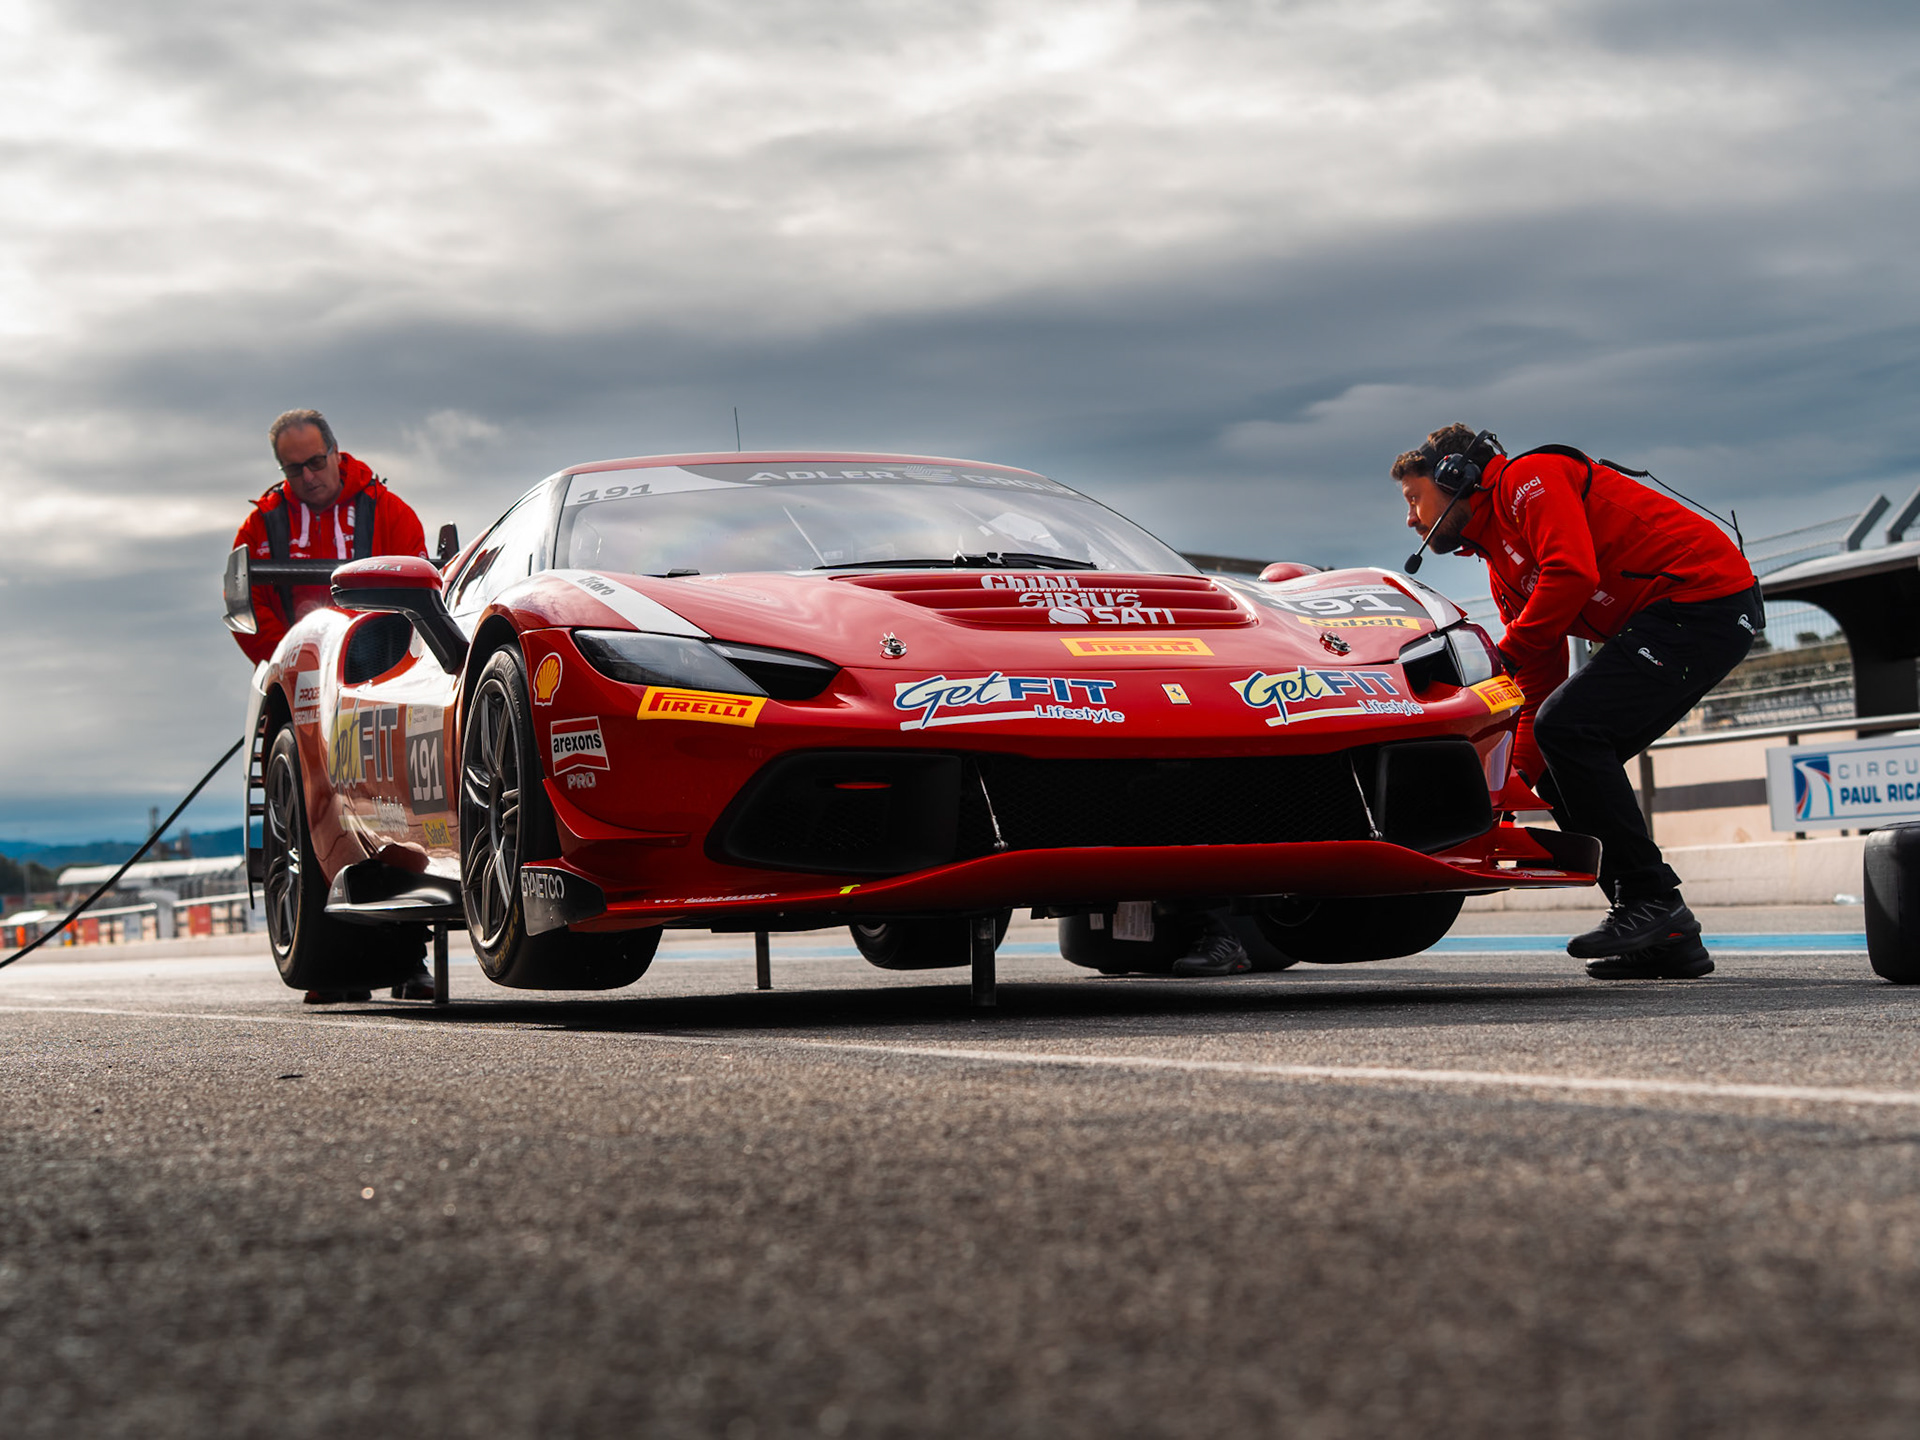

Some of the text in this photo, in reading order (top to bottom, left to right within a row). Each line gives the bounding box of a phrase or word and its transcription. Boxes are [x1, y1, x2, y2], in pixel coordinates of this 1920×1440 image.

[747, 470, 902, 481] ADLER
[577, 484, 652, 503] 191
[980, 574, 1079, 589] Ghibli
[1091, 608, 1176, 624] SATI
[1311, 618, 1407, 628] Sabelt
[1076, 640, 1198, 652] PIRELLI
[647, 692, 753, 718] PIRELLI
[1361, 700, 1424, 715] Lifestyle
[1037, 706, 1124, 721] Lifestyle
[552, 732, 602, 754] arexons
[410, 737, 444, 802] 191
[567, 772, 597, 790] PRO
[1840, 785, 1881, 805] PAUL
